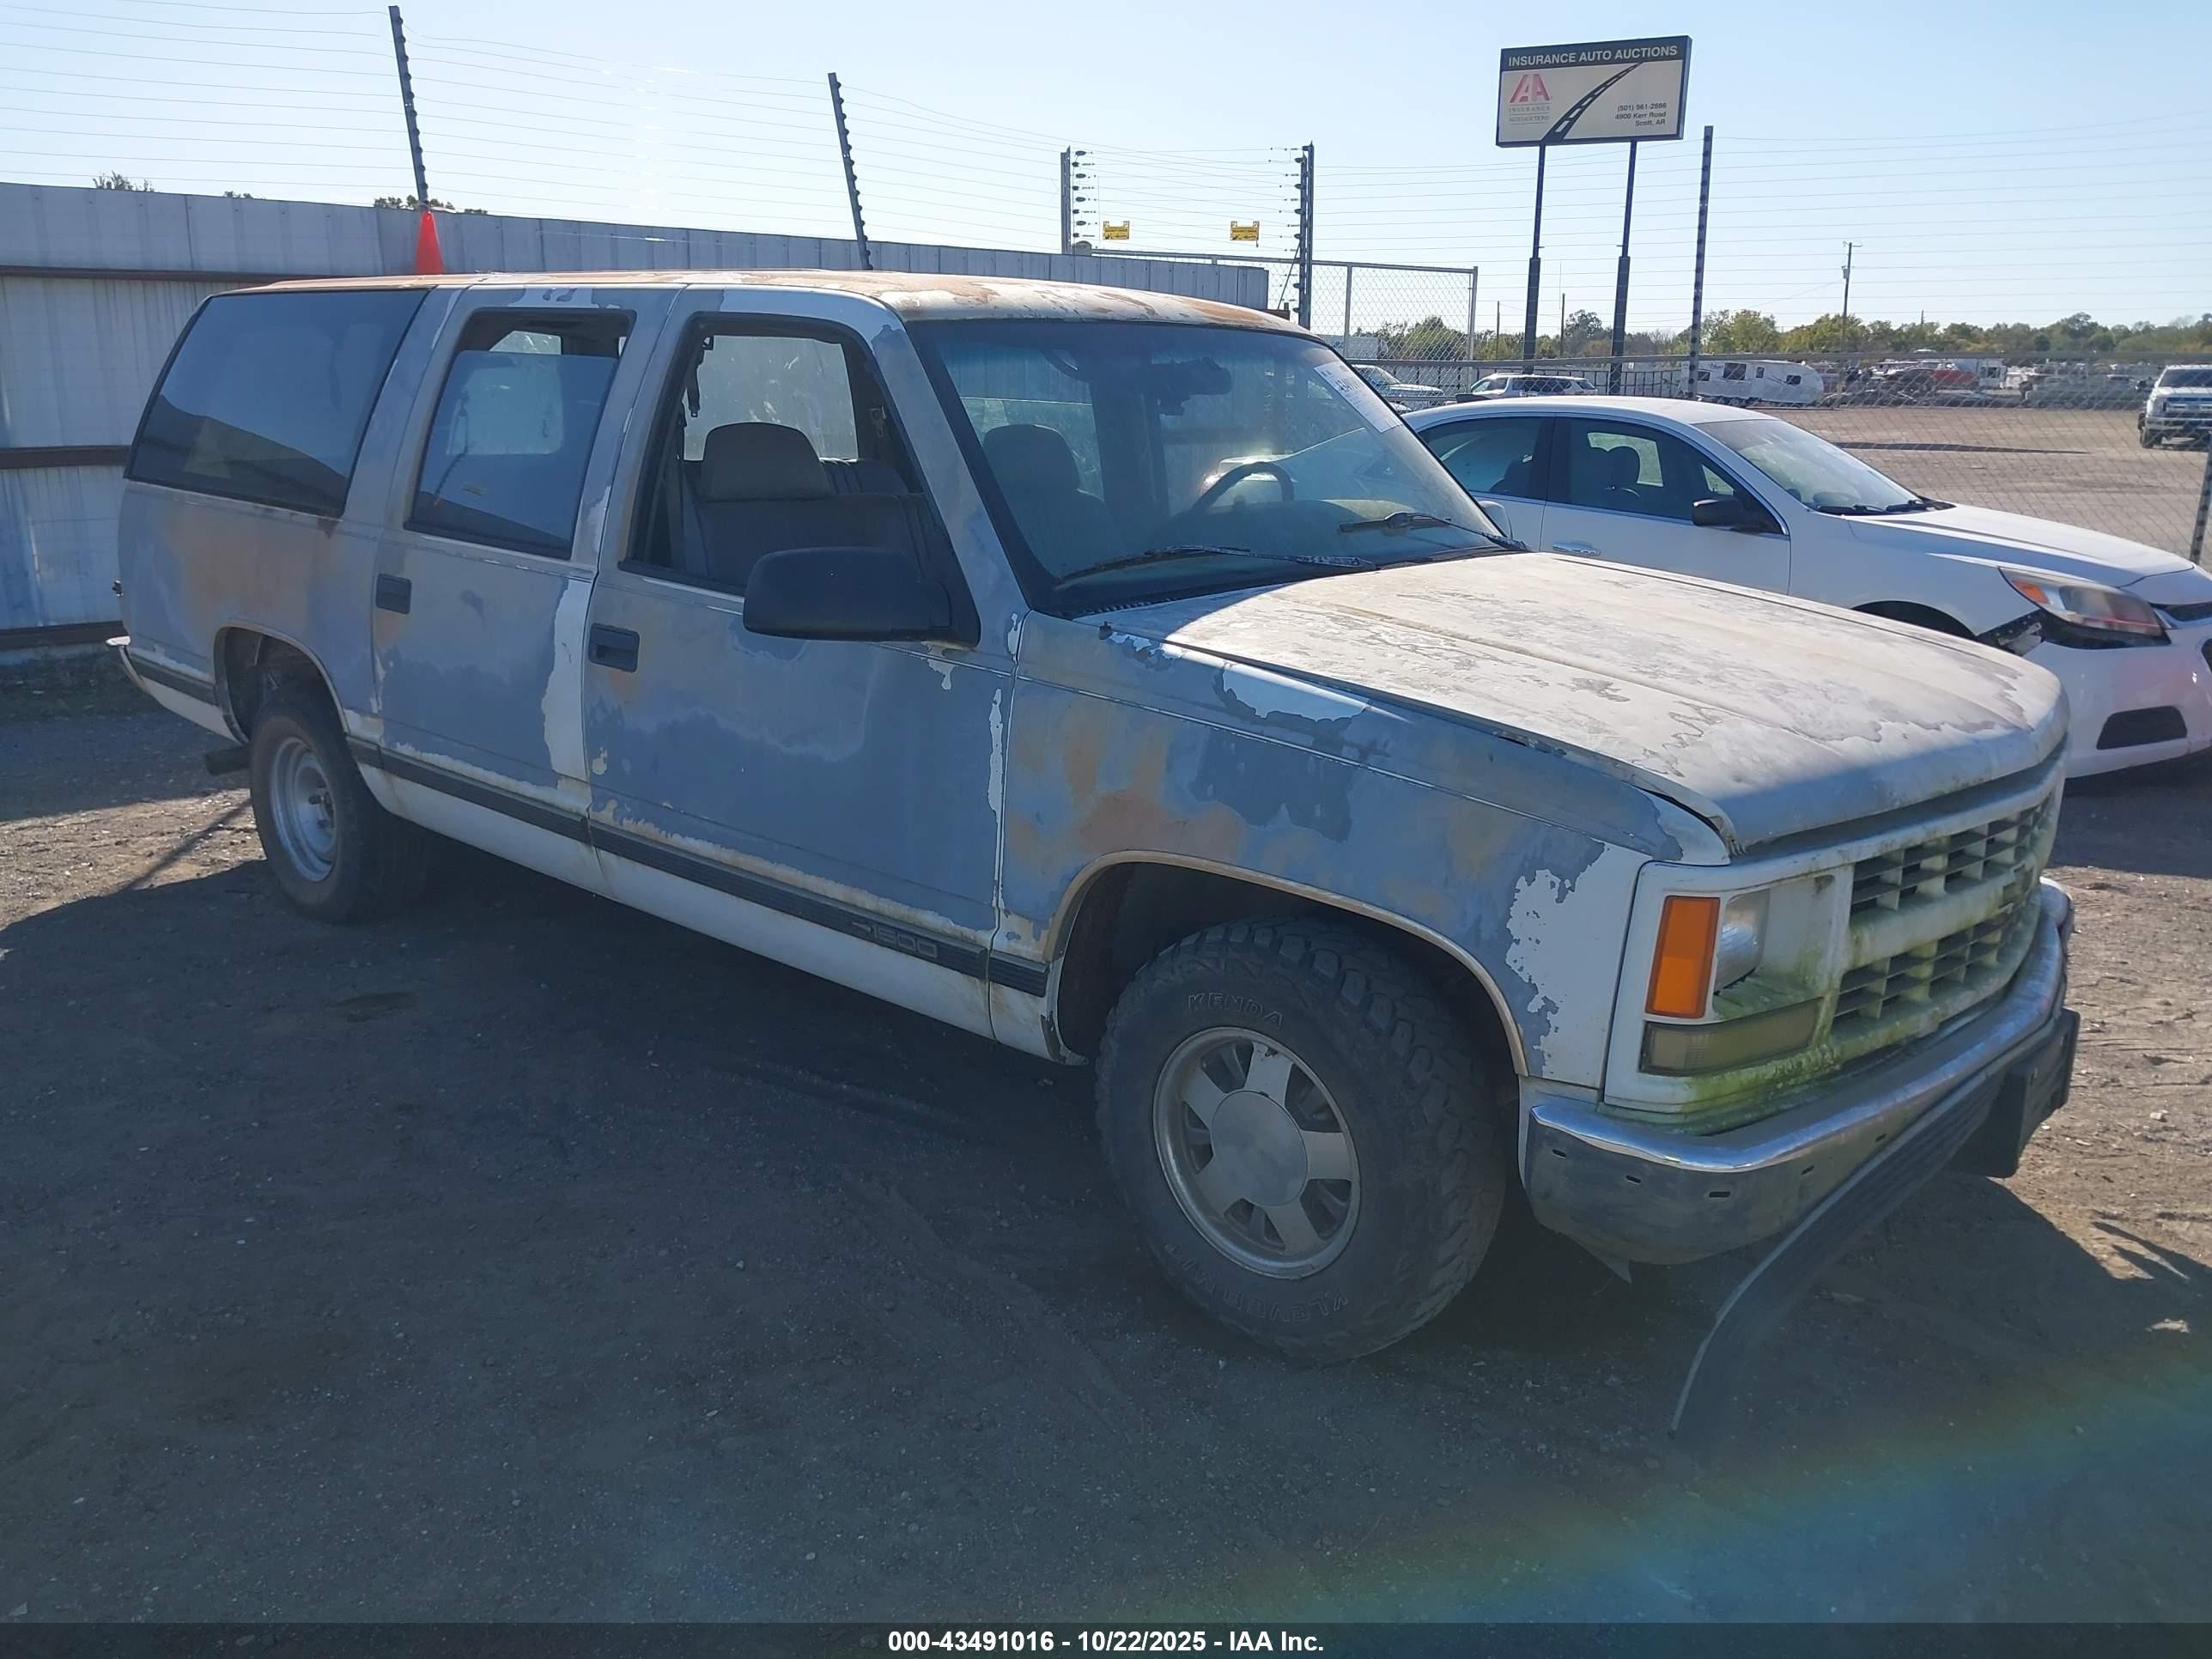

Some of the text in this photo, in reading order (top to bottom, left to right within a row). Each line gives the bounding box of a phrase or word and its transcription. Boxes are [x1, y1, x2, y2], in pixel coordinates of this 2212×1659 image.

[1508, 45, 1678, 67] INSURANCE AUTO AUCTIONS
[1617, 104, 1634, 112] (501)
[1188, 991, 1285, 1031] KENDA
